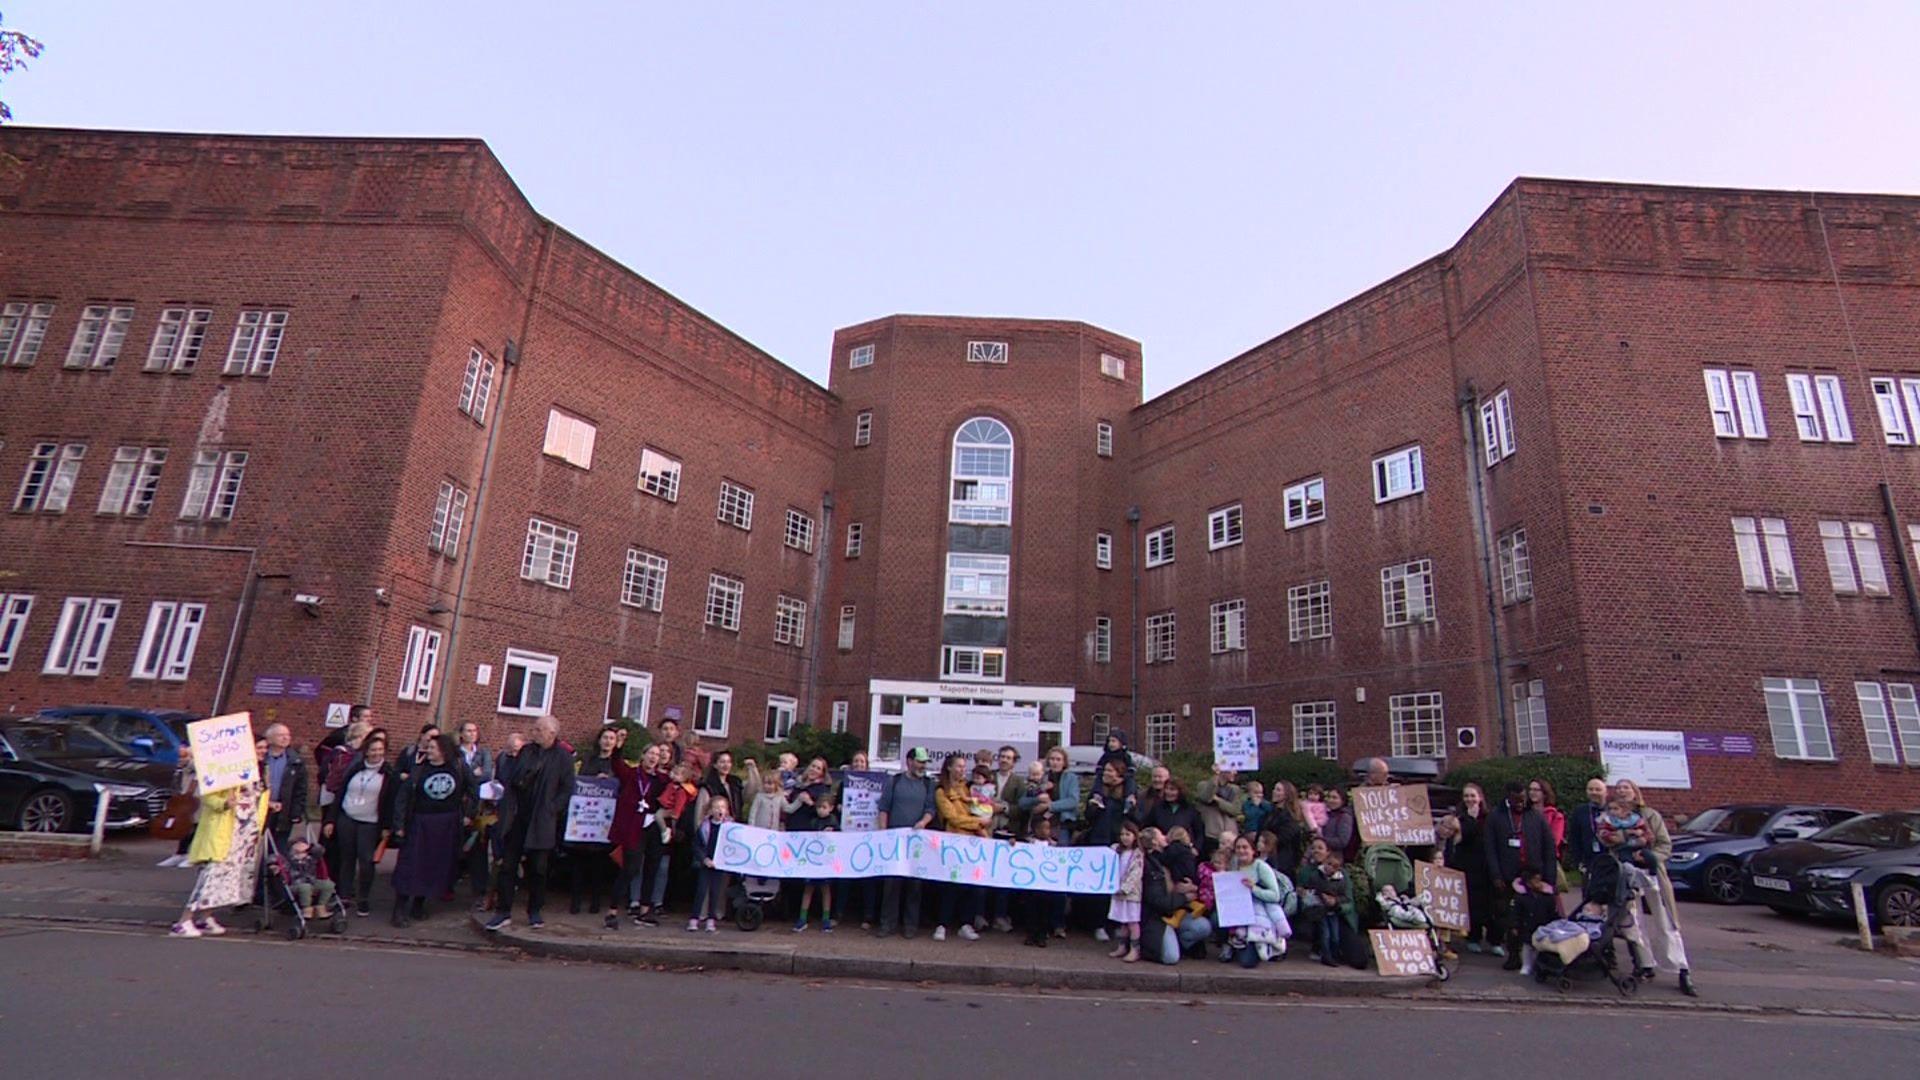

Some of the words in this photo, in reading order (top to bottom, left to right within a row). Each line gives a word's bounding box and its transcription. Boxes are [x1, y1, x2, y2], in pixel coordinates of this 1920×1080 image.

[1218, 715, 1250, 725] UNISON
[1604, 740, 1649, 750] Mapother
[1651, 742, 1681, 751] House
[848, 780, 882, 791] UNISON
[1360, 789, 1398, 809] YOUR
[1361, 807, 1409, 824] NURSES
[725, 826, 824, 867] Save
[850, 834, 922, 872] our
[1422, 867, 1463, 895] SAVE
[1376, 933, 1386, 949] I
[1390, 933, 1427, 948] WANT
[1382, 949, 1399, 961] TO
[1402, 949, 1423, 961] GO
[1396, 955, 1437, 974] TOO!
